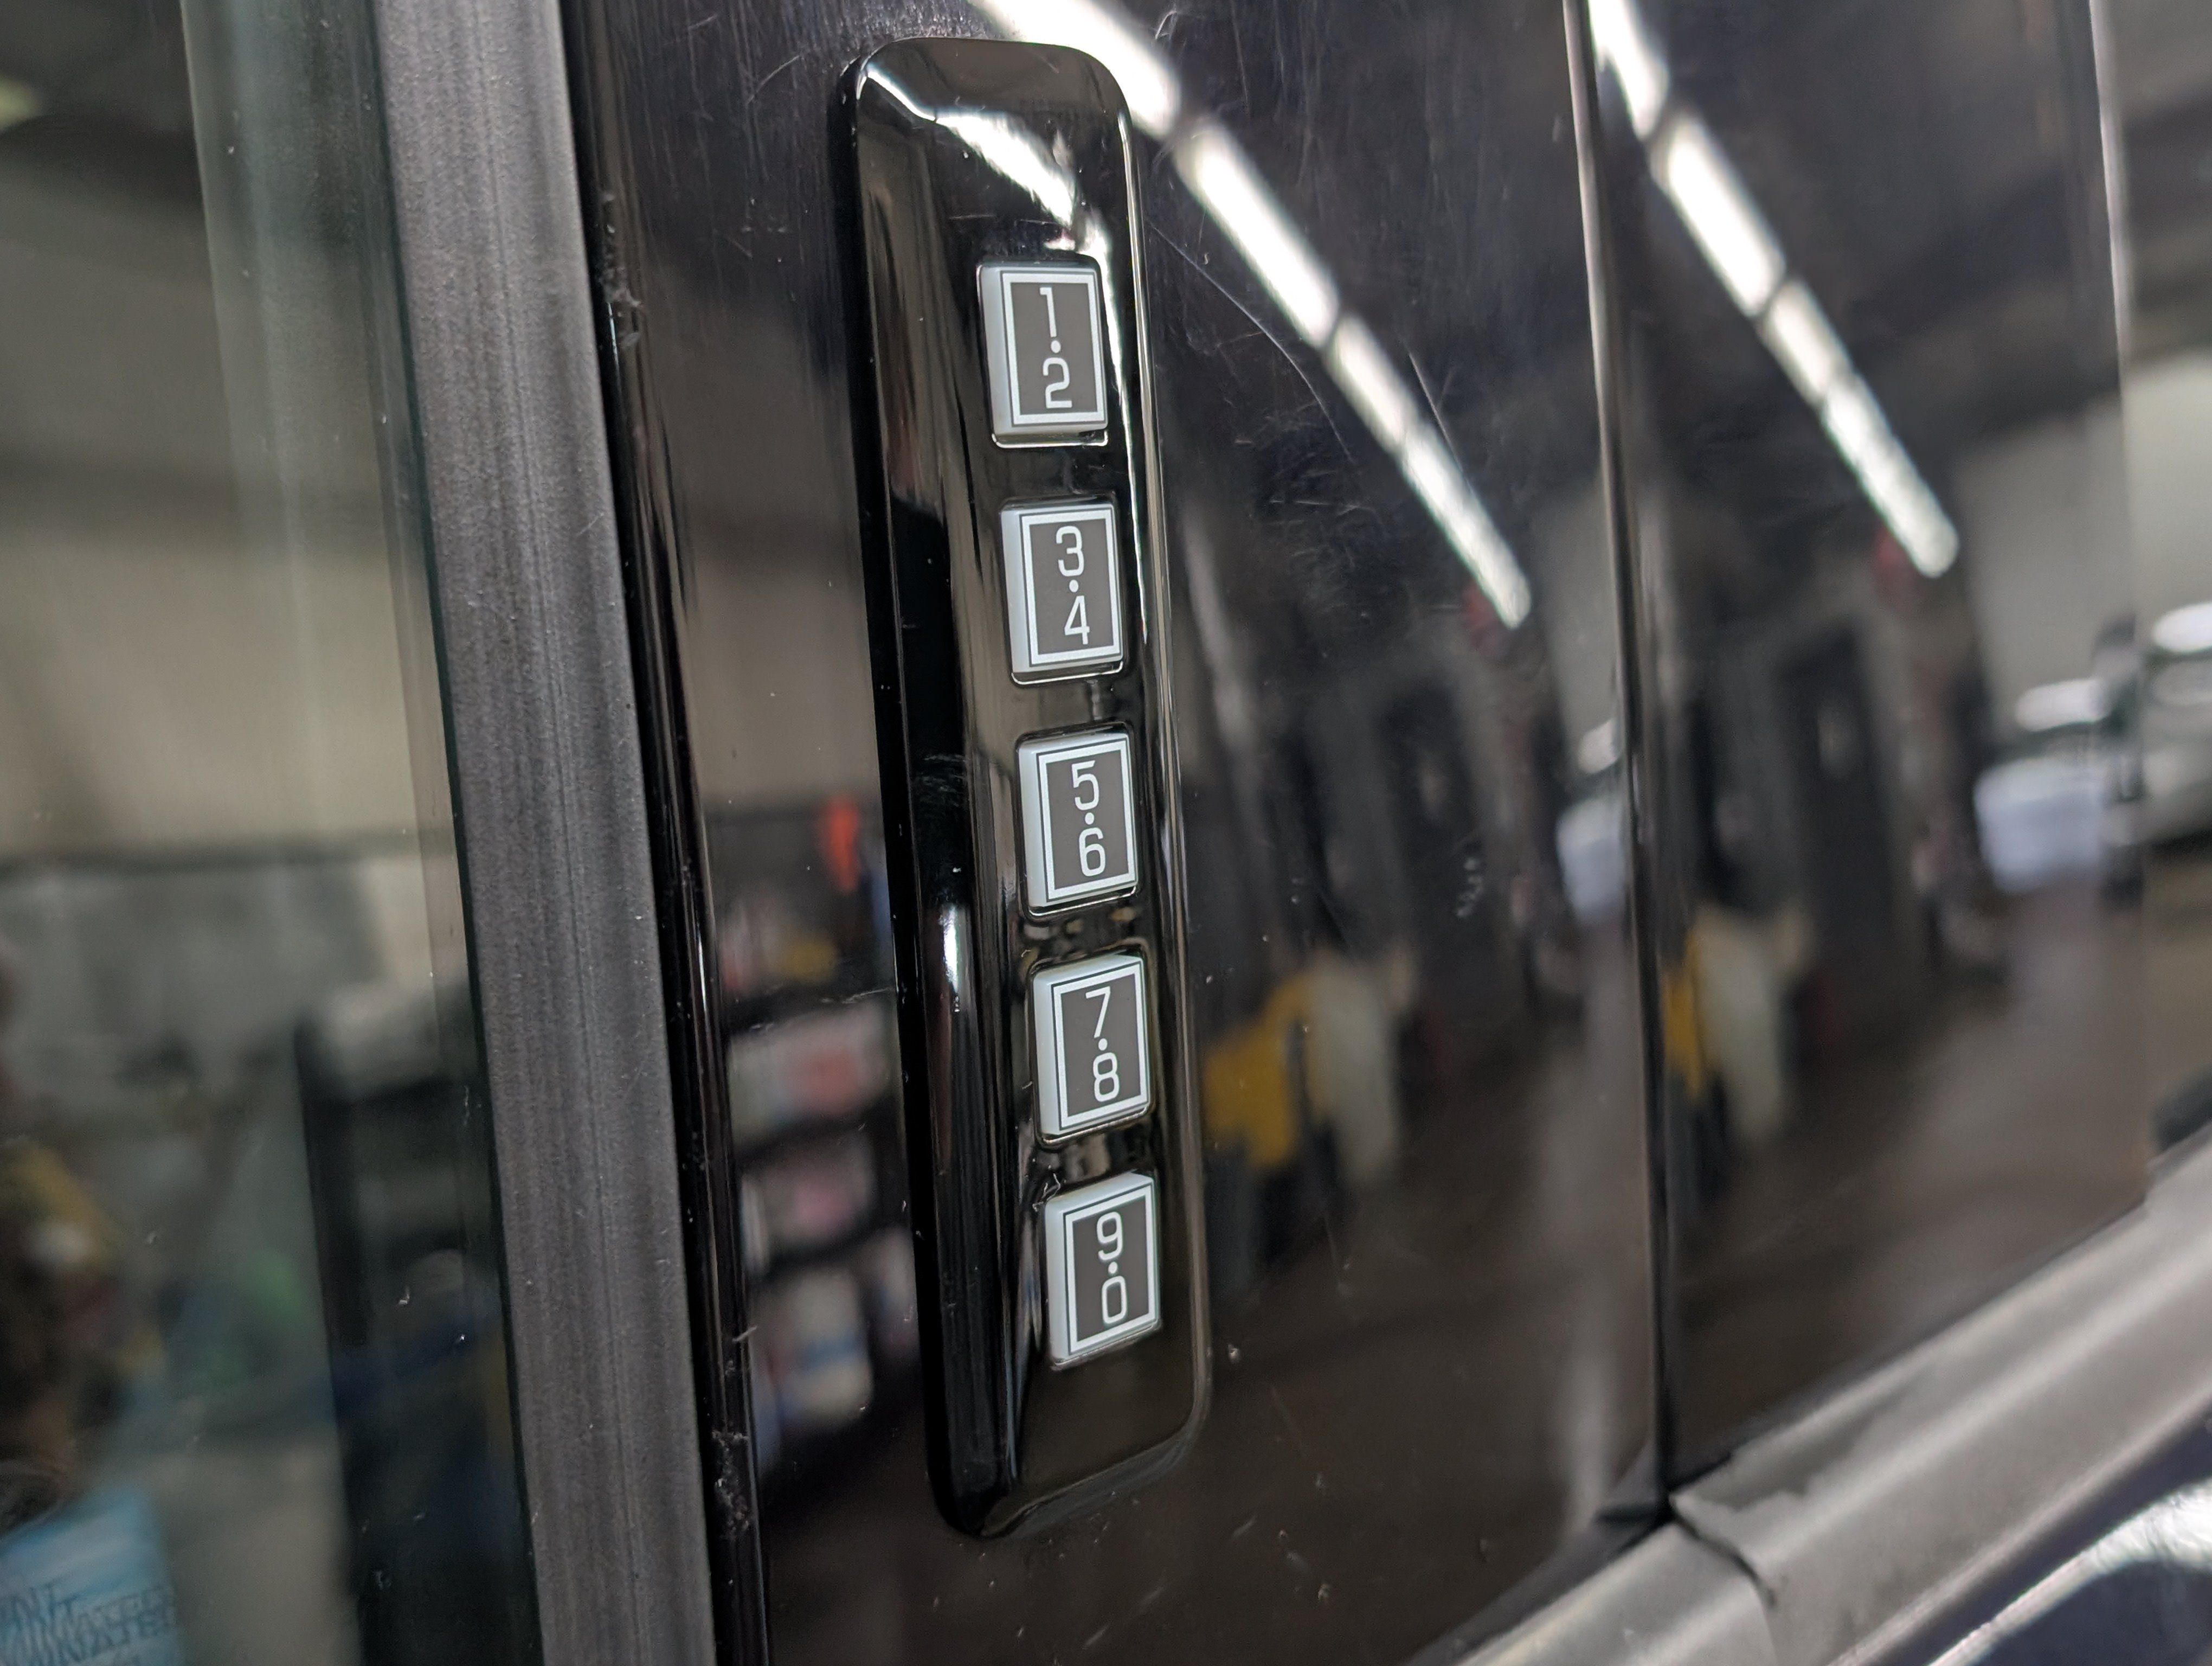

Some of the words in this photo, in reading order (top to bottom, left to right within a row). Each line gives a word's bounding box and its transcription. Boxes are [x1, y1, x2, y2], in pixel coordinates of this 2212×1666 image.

[1039, 286, 1057, 338] 1
[1042, 356, 1073, 409] 2
[1055, 525, 1085, 577] 3
[1064, 594, 1091, 645] 4
[1071, 759, 1100, 811] 5
[1078, 826, 1106, 877] 6
[1085, 985, 1111, 1039] 7
[1092, 1052, 1120, 1103] 8
[1096, 1211, 1124, 1262] 9
[1101, 1275, 1128, 1325] 0
